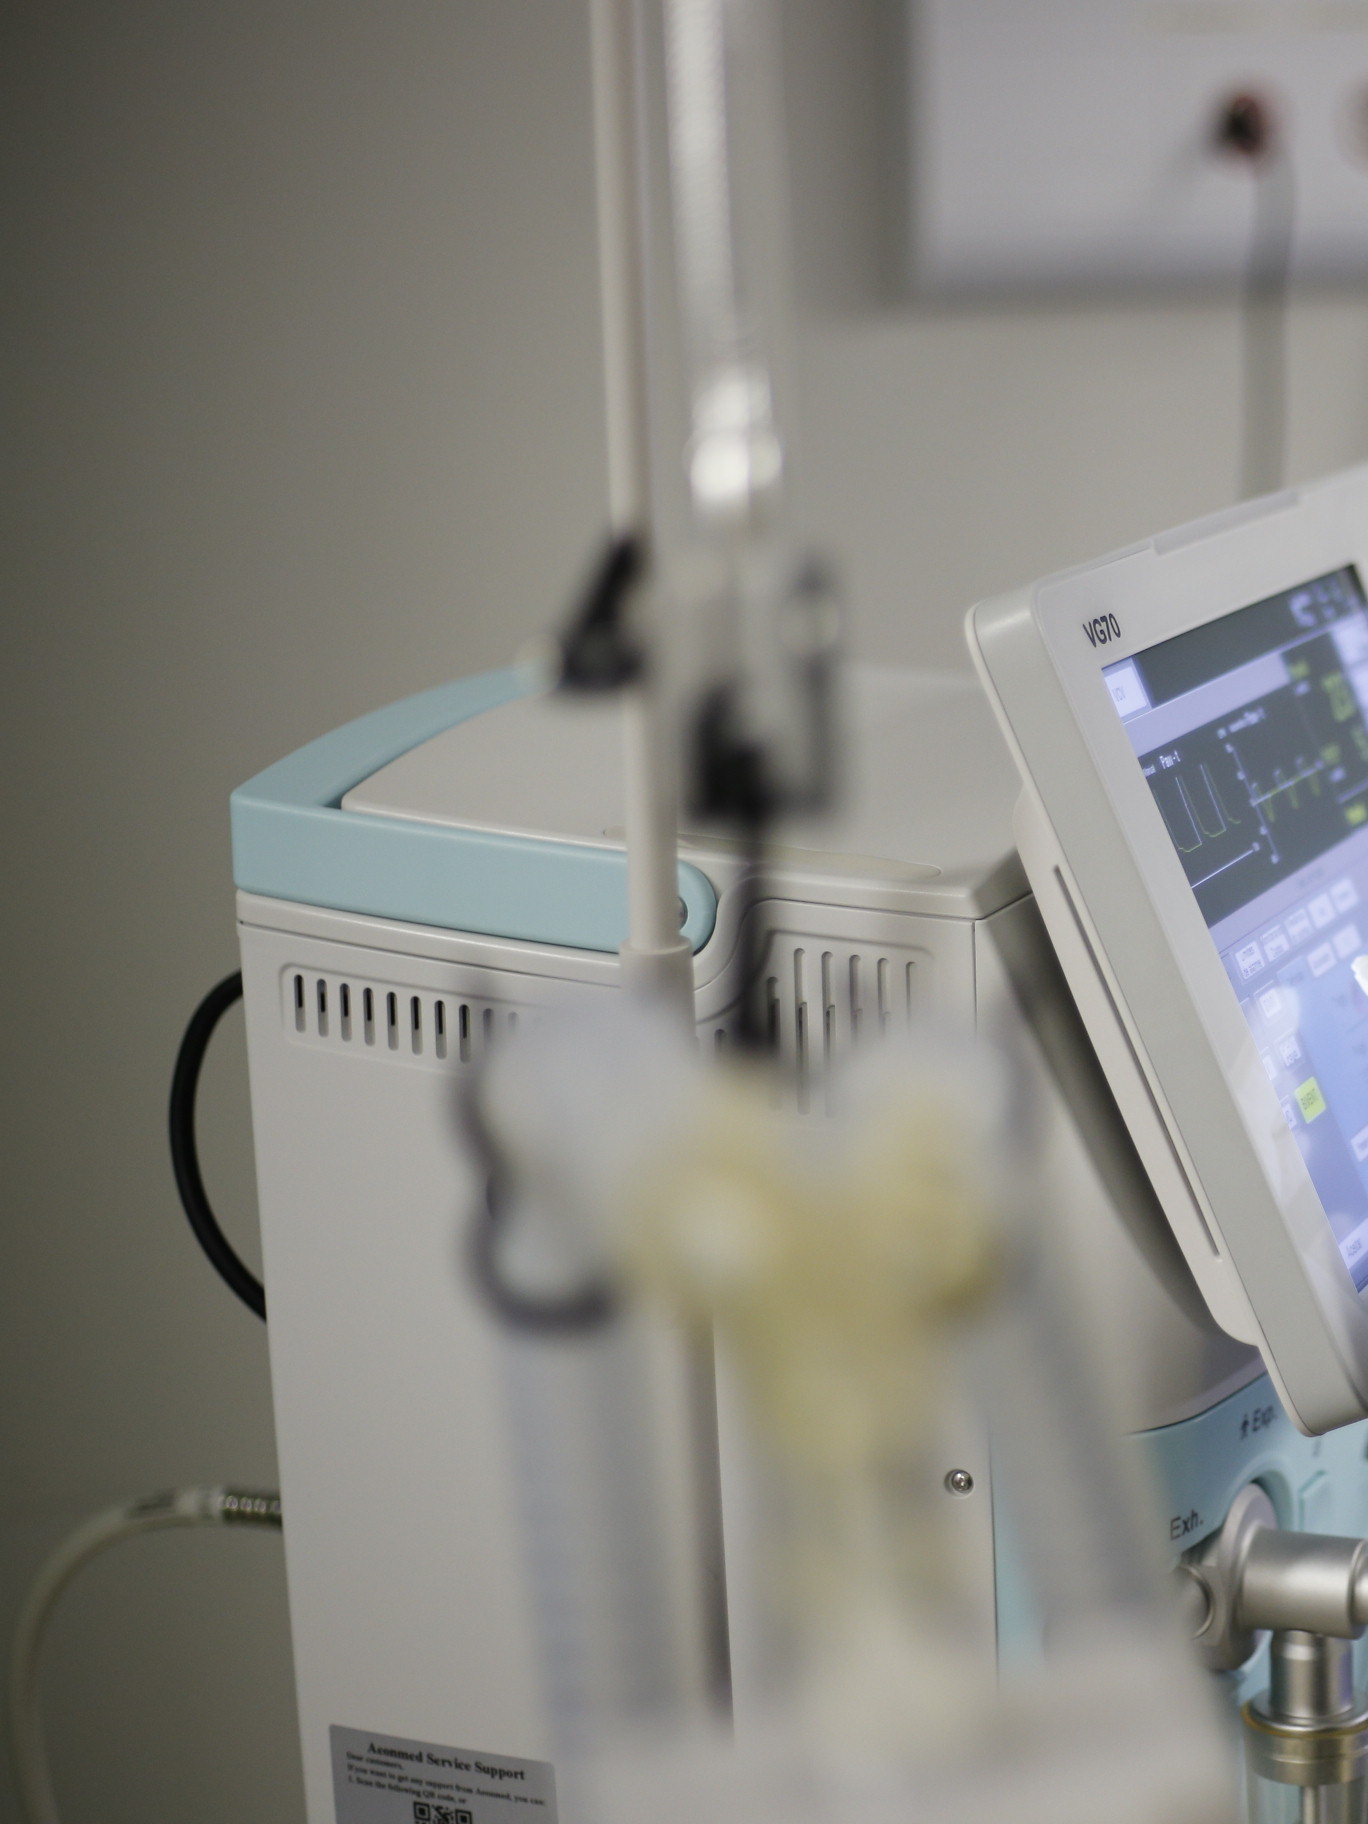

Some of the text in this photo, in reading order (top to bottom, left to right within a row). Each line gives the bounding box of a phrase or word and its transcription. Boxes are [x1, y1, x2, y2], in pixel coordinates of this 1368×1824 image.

[1082, 613, 1121, 648] VG70
[1170, 1509, 1204, 1541] Exh.
[426, 1753, 472, 1772] Service
[474, 1761, 525, 1781] Support
[355, 1766, 368, 1774] you
[370, 1769, 387, 1777] want
[388, 1771, 395, 1779] to
[397, 1775, 408, 1783] get
[411, 1777, 423, 1785] any
[455, 1784, 473, 1794] from
[514, 1794, 528, 1803] you
[356, 1777, 373, 1787] Scan
[375, 1779, 386, 1788] the
[388, 1783, 421, 1798] following
[423, 1790, 435, 1799] QR
